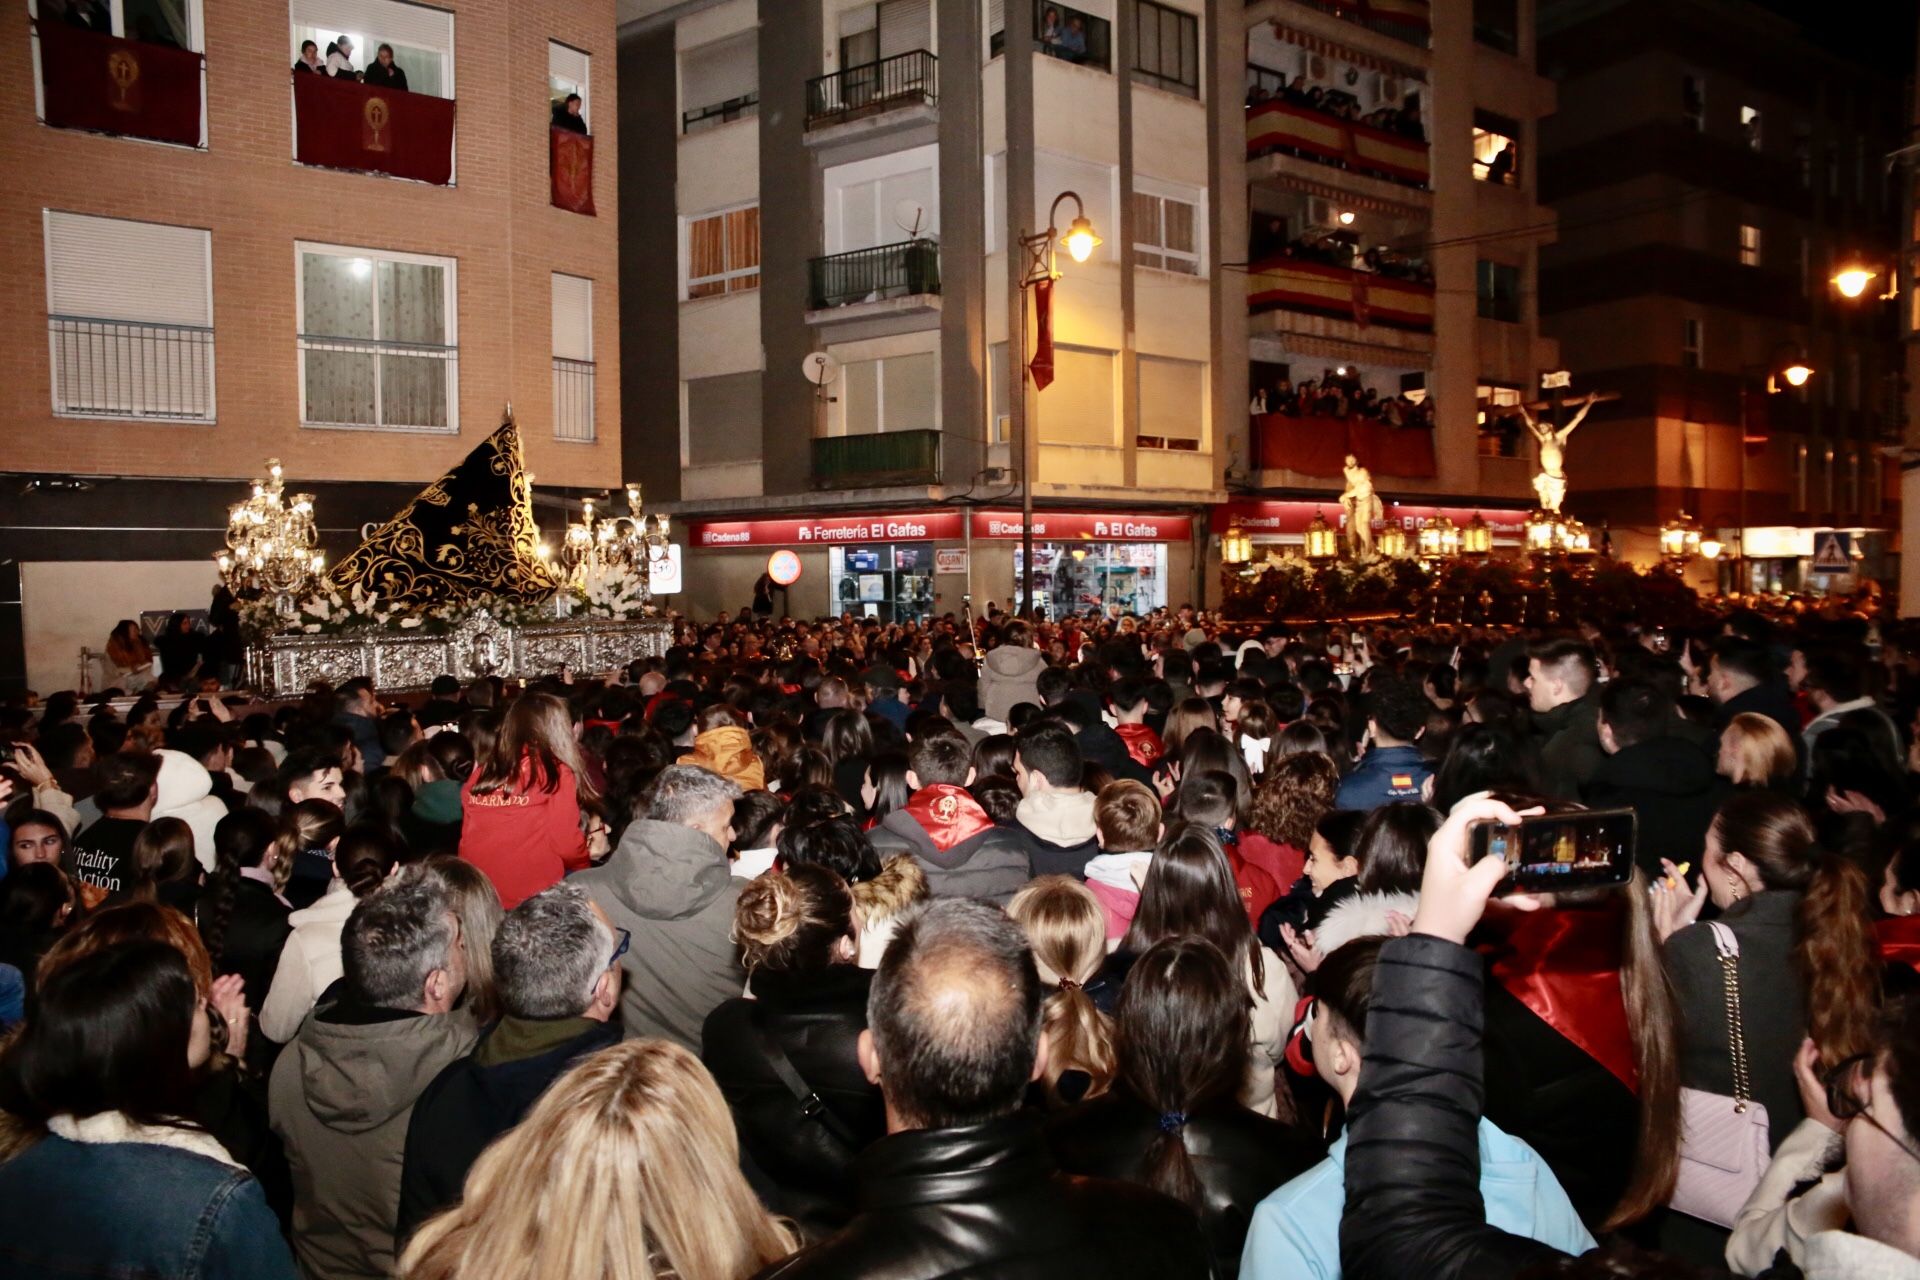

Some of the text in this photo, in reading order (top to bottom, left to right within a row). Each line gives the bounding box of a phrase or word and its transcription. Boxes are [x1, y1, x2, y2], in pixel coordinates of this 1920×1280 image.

[814, 524, 868, 540] Ferretería
[871, 523, 884, 538] El
[887, 522, 926, 538] Gafas
[1001, 523, 1046, 534] Cadea88
[1111, 522, 1123, 536] El
[1125, 522, 1157, 537] Gafas
